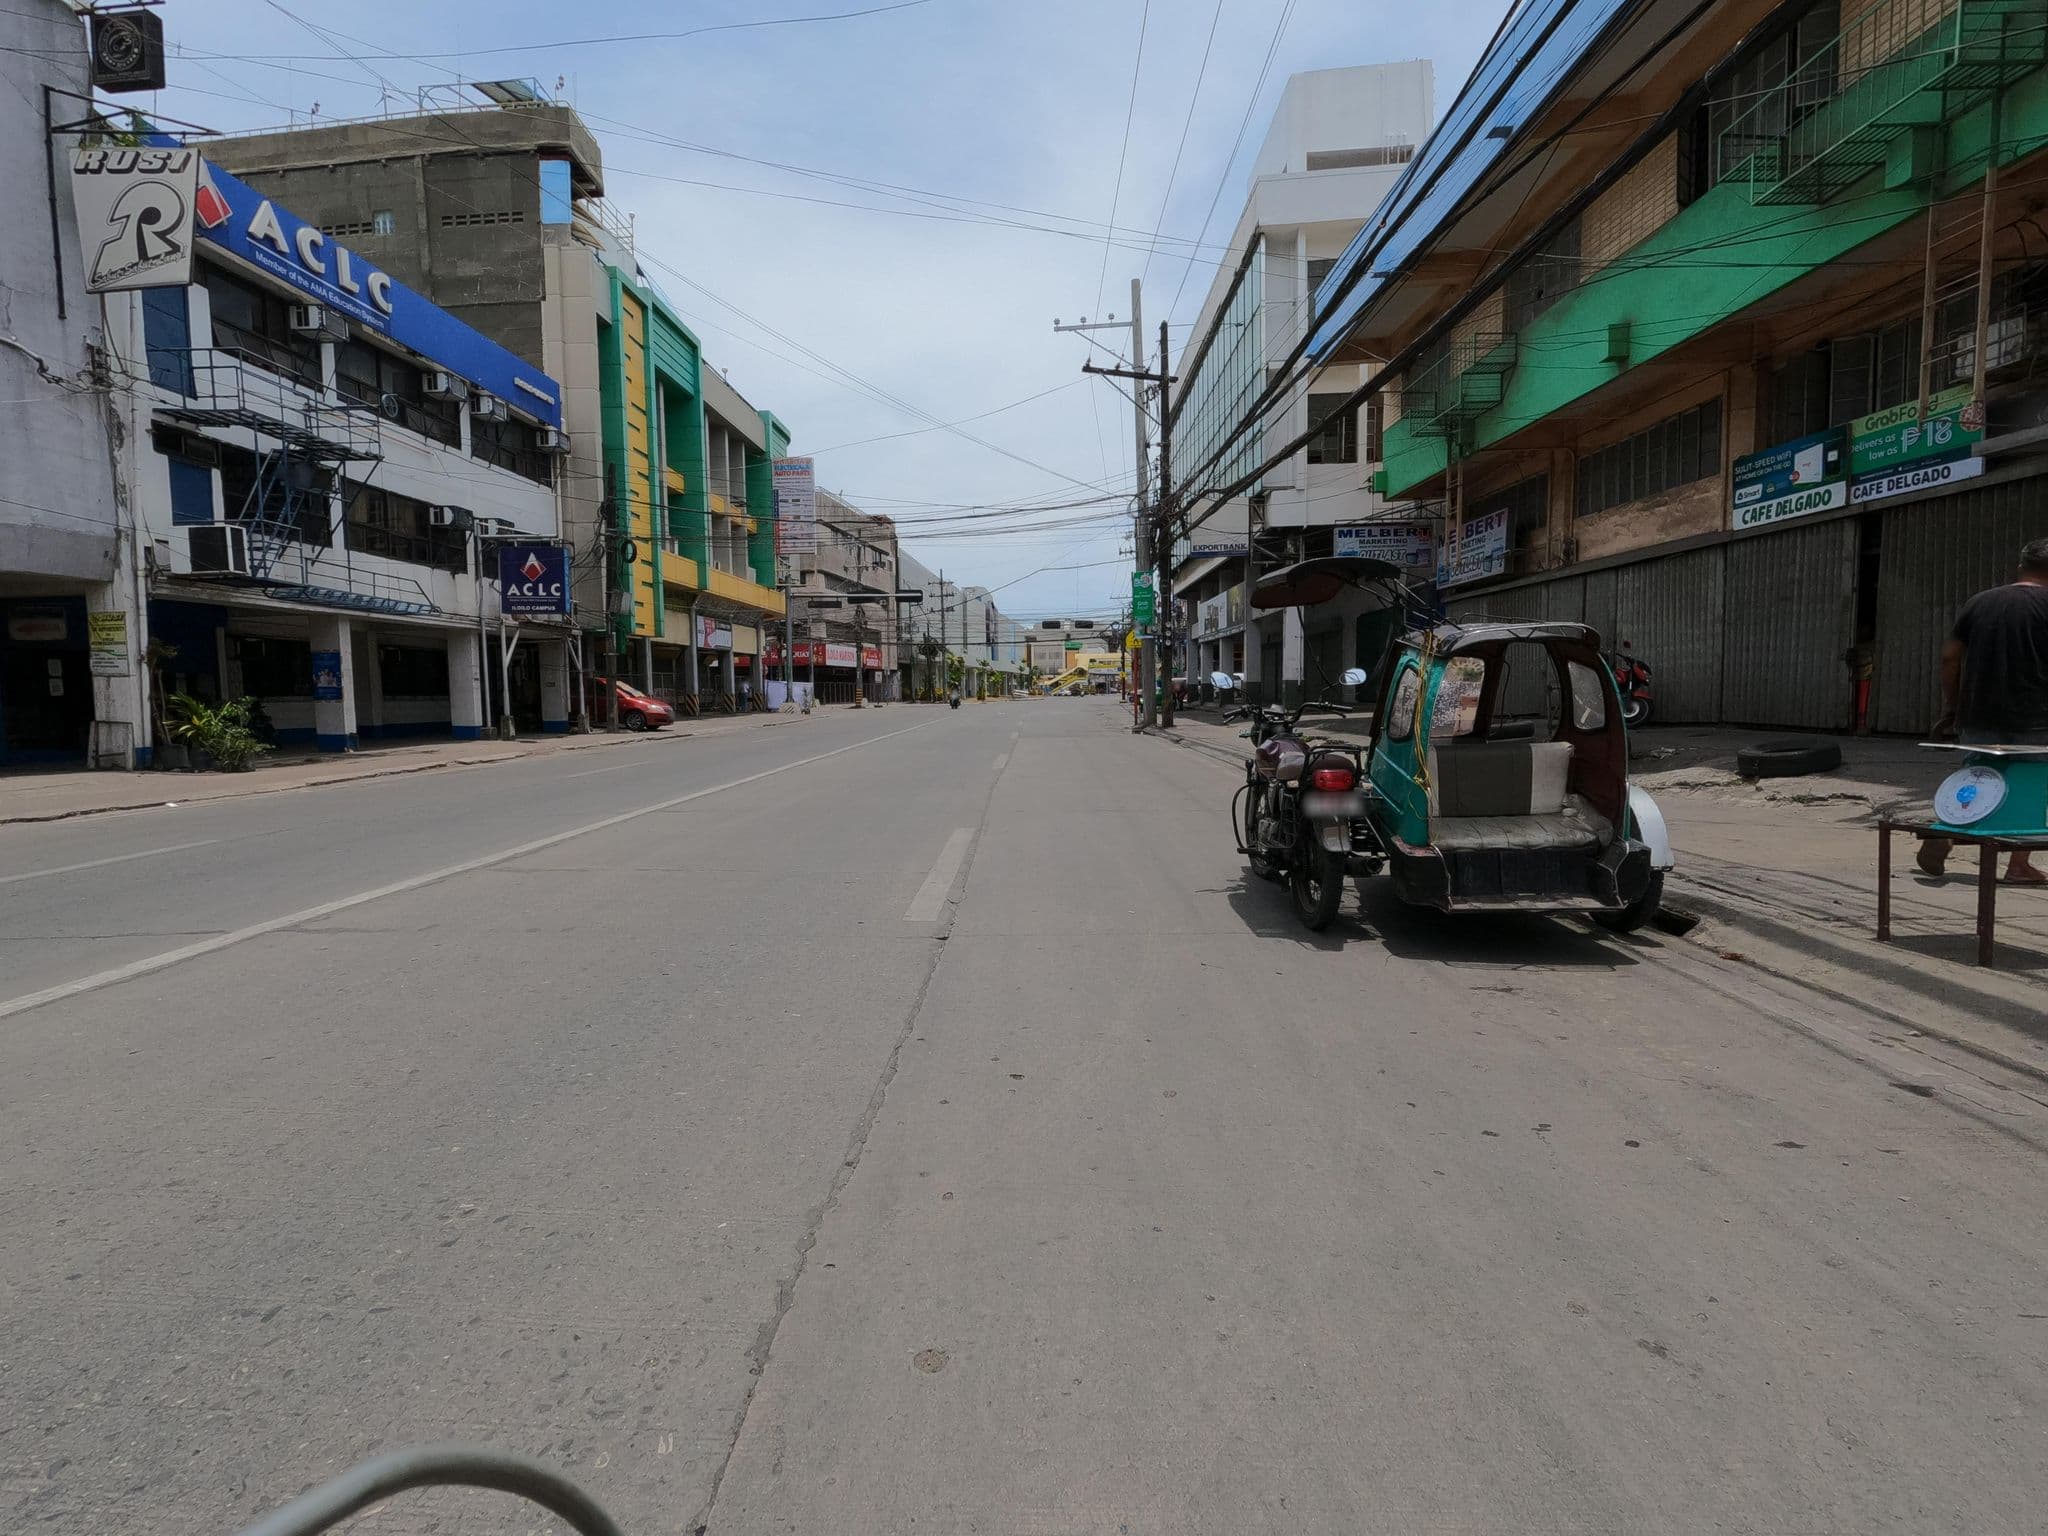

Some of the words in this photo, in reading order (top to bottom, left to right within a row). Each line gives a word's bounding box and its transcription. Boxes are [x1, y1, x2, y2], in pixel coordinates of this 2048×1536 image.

[74, 151, 192, 174] RUSI
[248, 200, 393, 313] ACLC
[255, 251, 288, 277] Member
[297, 275, 310, 288] the
[310, 283, 328, 298] AMA
[328, 291, 363, 317] Education
[361, 310, 385, 329] System
[1865, 395, 1939, 431] GrabFod
[1885, 434, 1896, 443] as
[1868, 450, 1885, 461] low
[1887, 447, 1898, 456] as
[1853, 483, 1883, 499] CAFE
[1887, 466, 1952, 491] DELGADO
[1743, 487, 1760, 498] Smart
[1742, 502, 1773, 525] CAFE
[1775, 489, 1833, 518] DELGADO
[1338, 528, 1431, 538] MELBERT
[1438, 511, 1504, 549] MEBERT
[1193, 543, 1248, 552] EXPORTBANK
[1360, 549, 1406, 561] OUTLAST
[507, 583, 561, 596] ACLC
